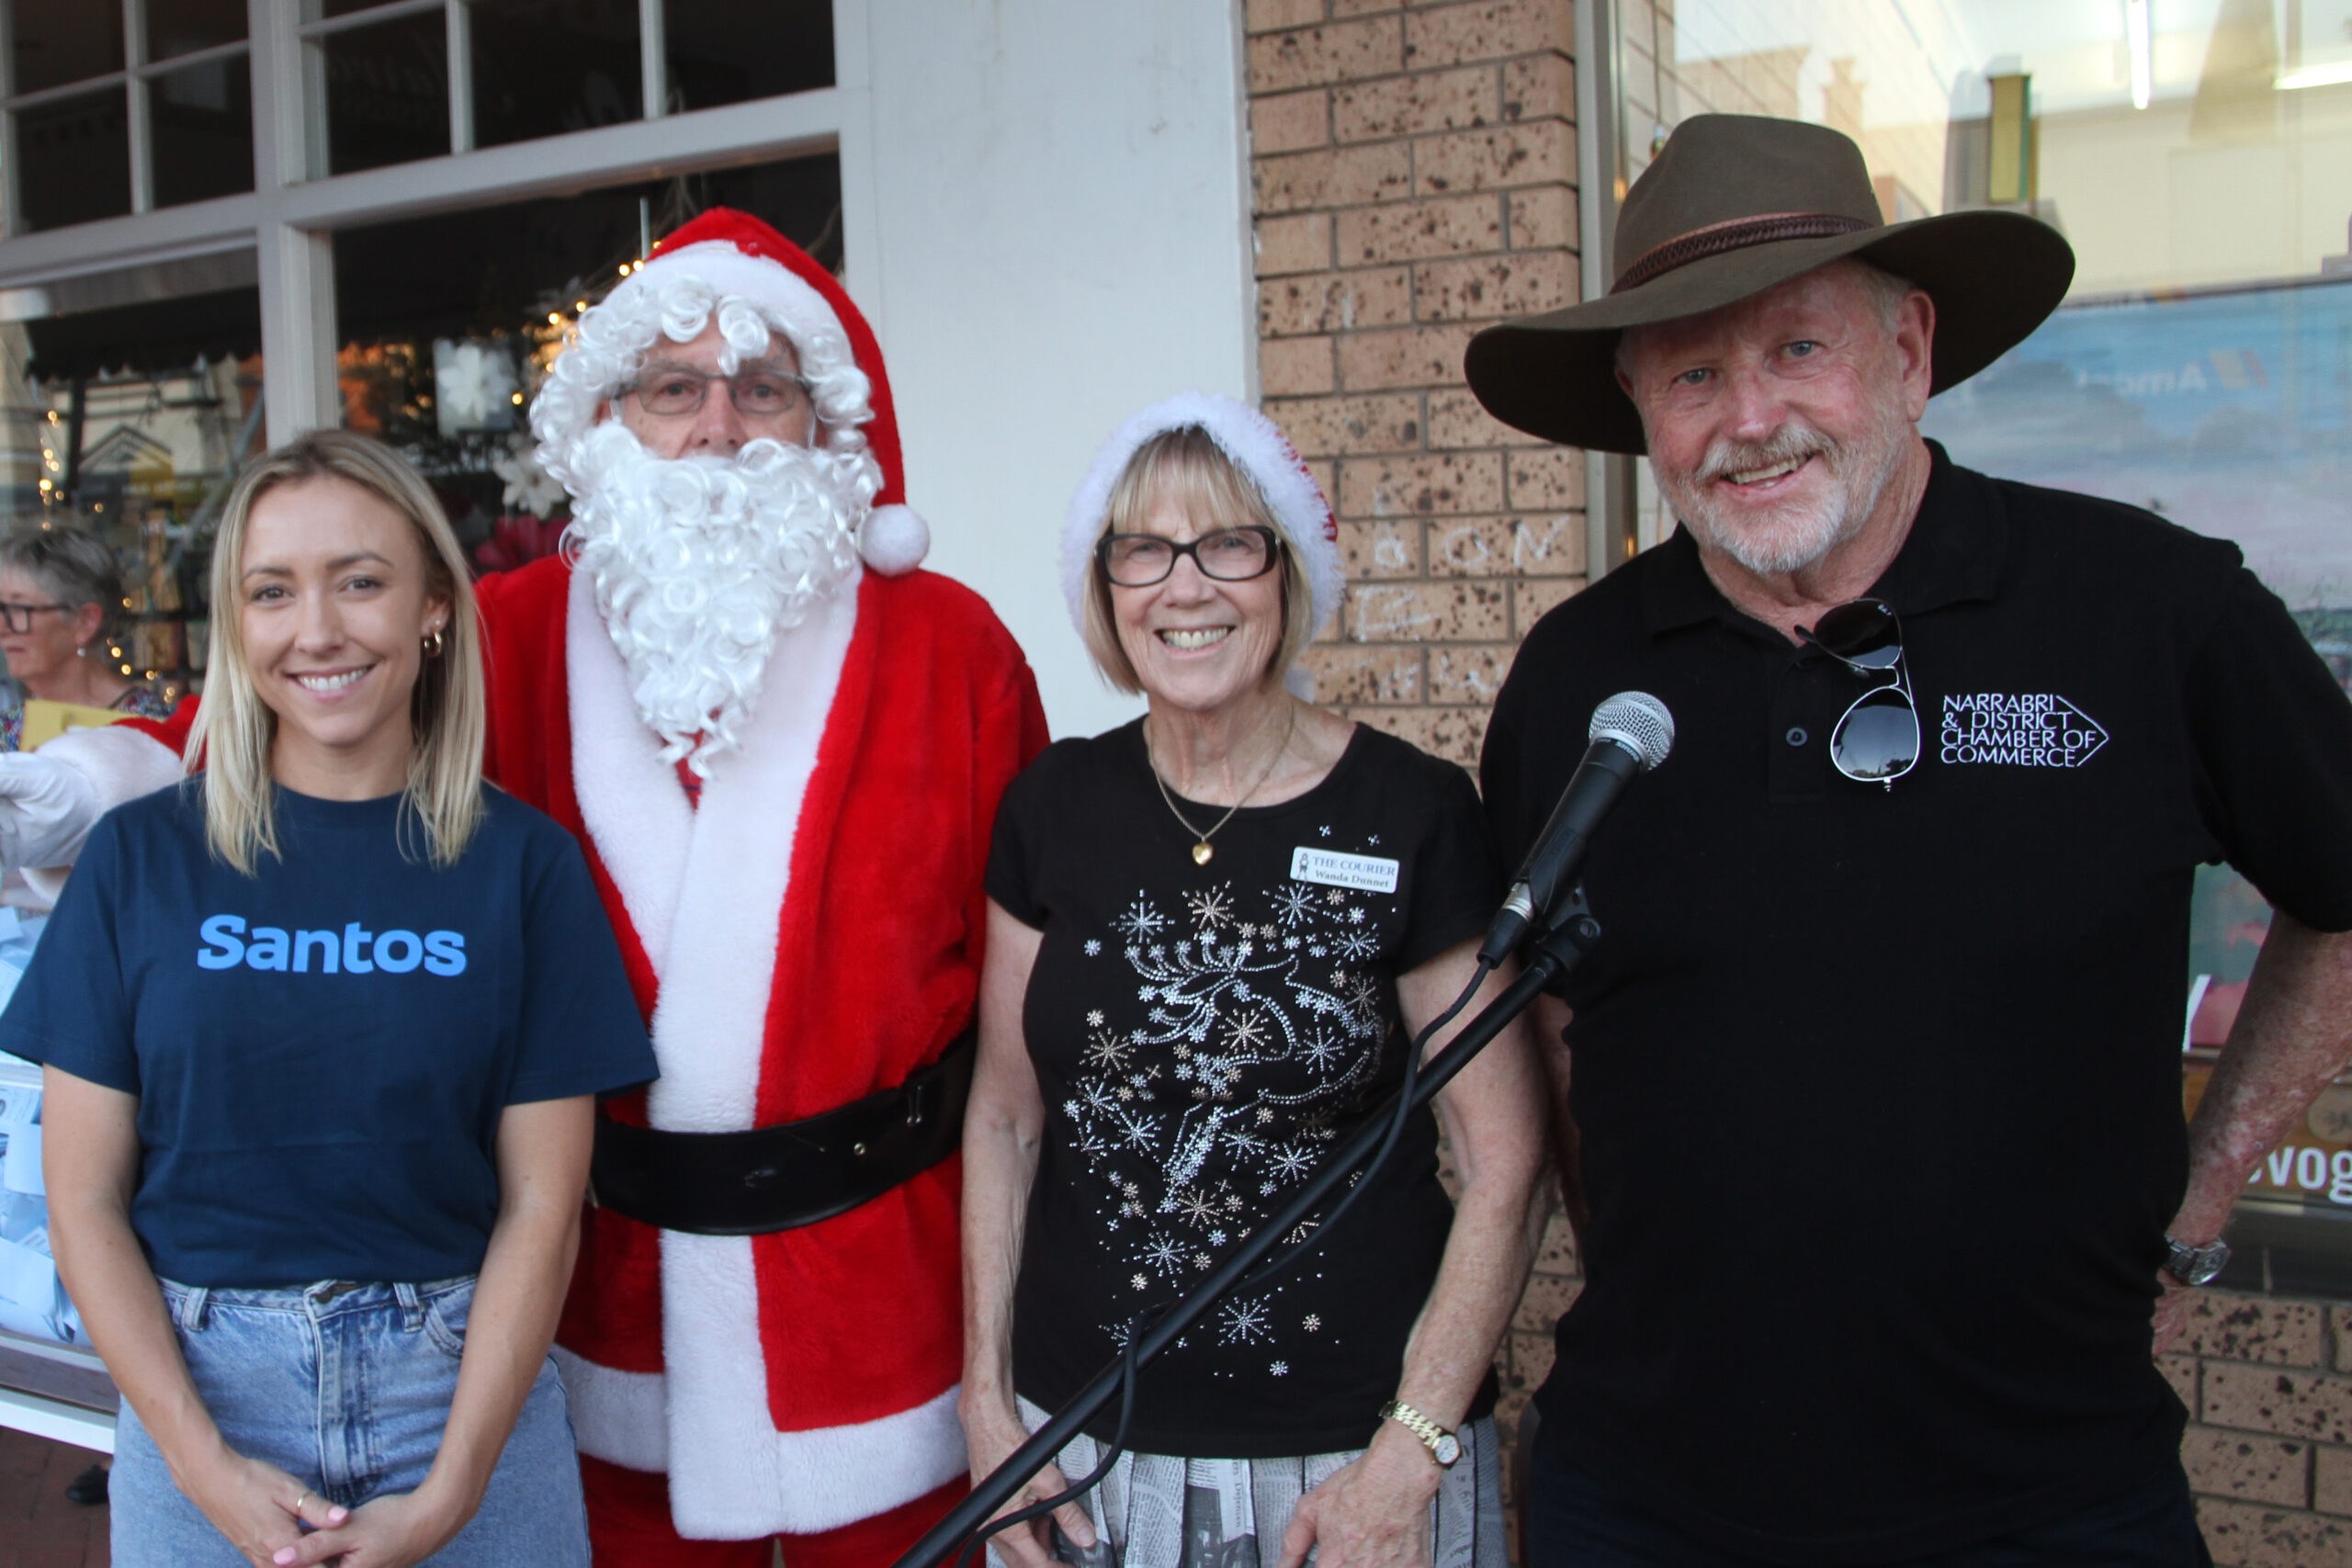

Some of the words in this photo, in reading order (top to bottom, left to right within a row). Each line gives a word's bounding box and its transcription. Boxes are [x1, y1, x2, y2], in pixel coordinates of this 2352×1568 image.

[1943, 693, 2054, 712] NARRABRI
[1941, 712, 1959, 728] &
[1972, 711, 2074, 730] DISTRICT
[1940, 727, 2056, 749] CHAMBER
[2063, 729, 2098, 750] OF
[1940, 745, 2075, 767] COMMERCE
[1314, 857, 1338, 868] THE
[1340, 860, 1396, 875] COURIER
[1316, 870, 1349, 883] Wanda
[196, 912, 469, 977] Santos
[2248, 1145, 2352, 1204] vog
